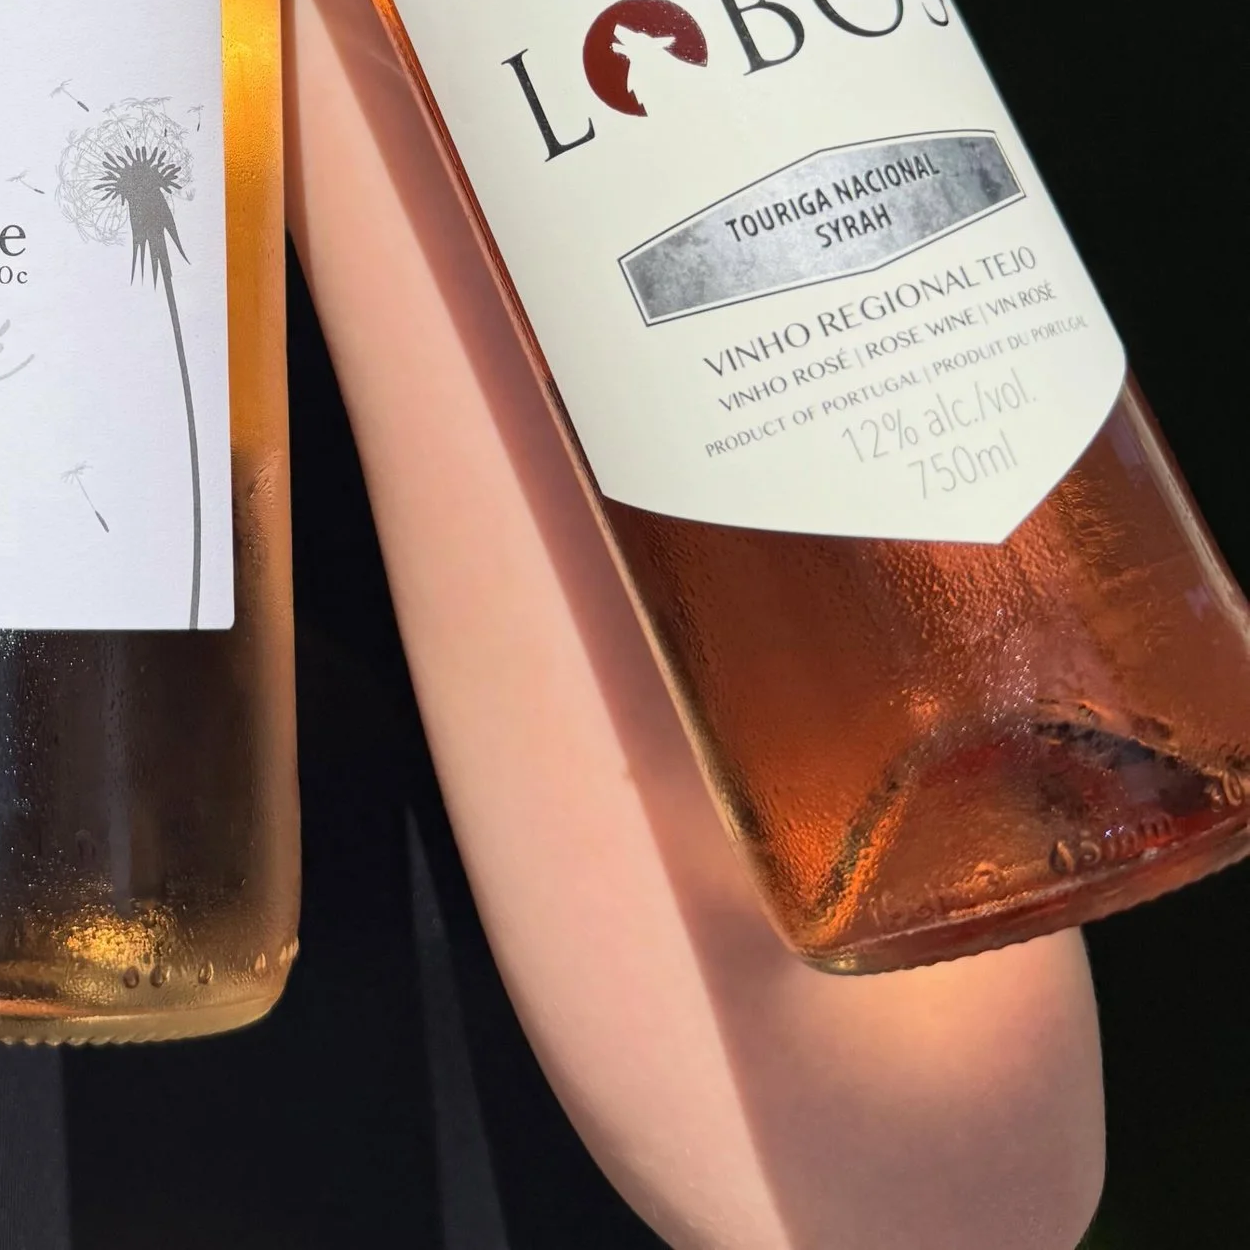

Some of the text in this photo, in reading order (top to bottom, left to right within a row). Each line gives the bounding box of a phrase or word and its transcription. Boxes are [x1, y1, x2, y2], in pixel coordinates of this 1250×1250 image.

[725, 152, 941, 243] TOURIGA NACIONAL
[815, 202, 892, 249] SYRAH
[703, 245, 1037, 377] VINHO REGIONAL TEJO
[718, 279, 1059, 413] VINHO ROSÉ ROSE WINE VIN ROSÉ
[704, 314, 1090, 458] PRODUCT OF PORTUGAL PRODUIT DU PORTUGAL
[841, 367, 1039, 463] 12% alc./vol.
[907, 427, 1019, 500] 750ml
